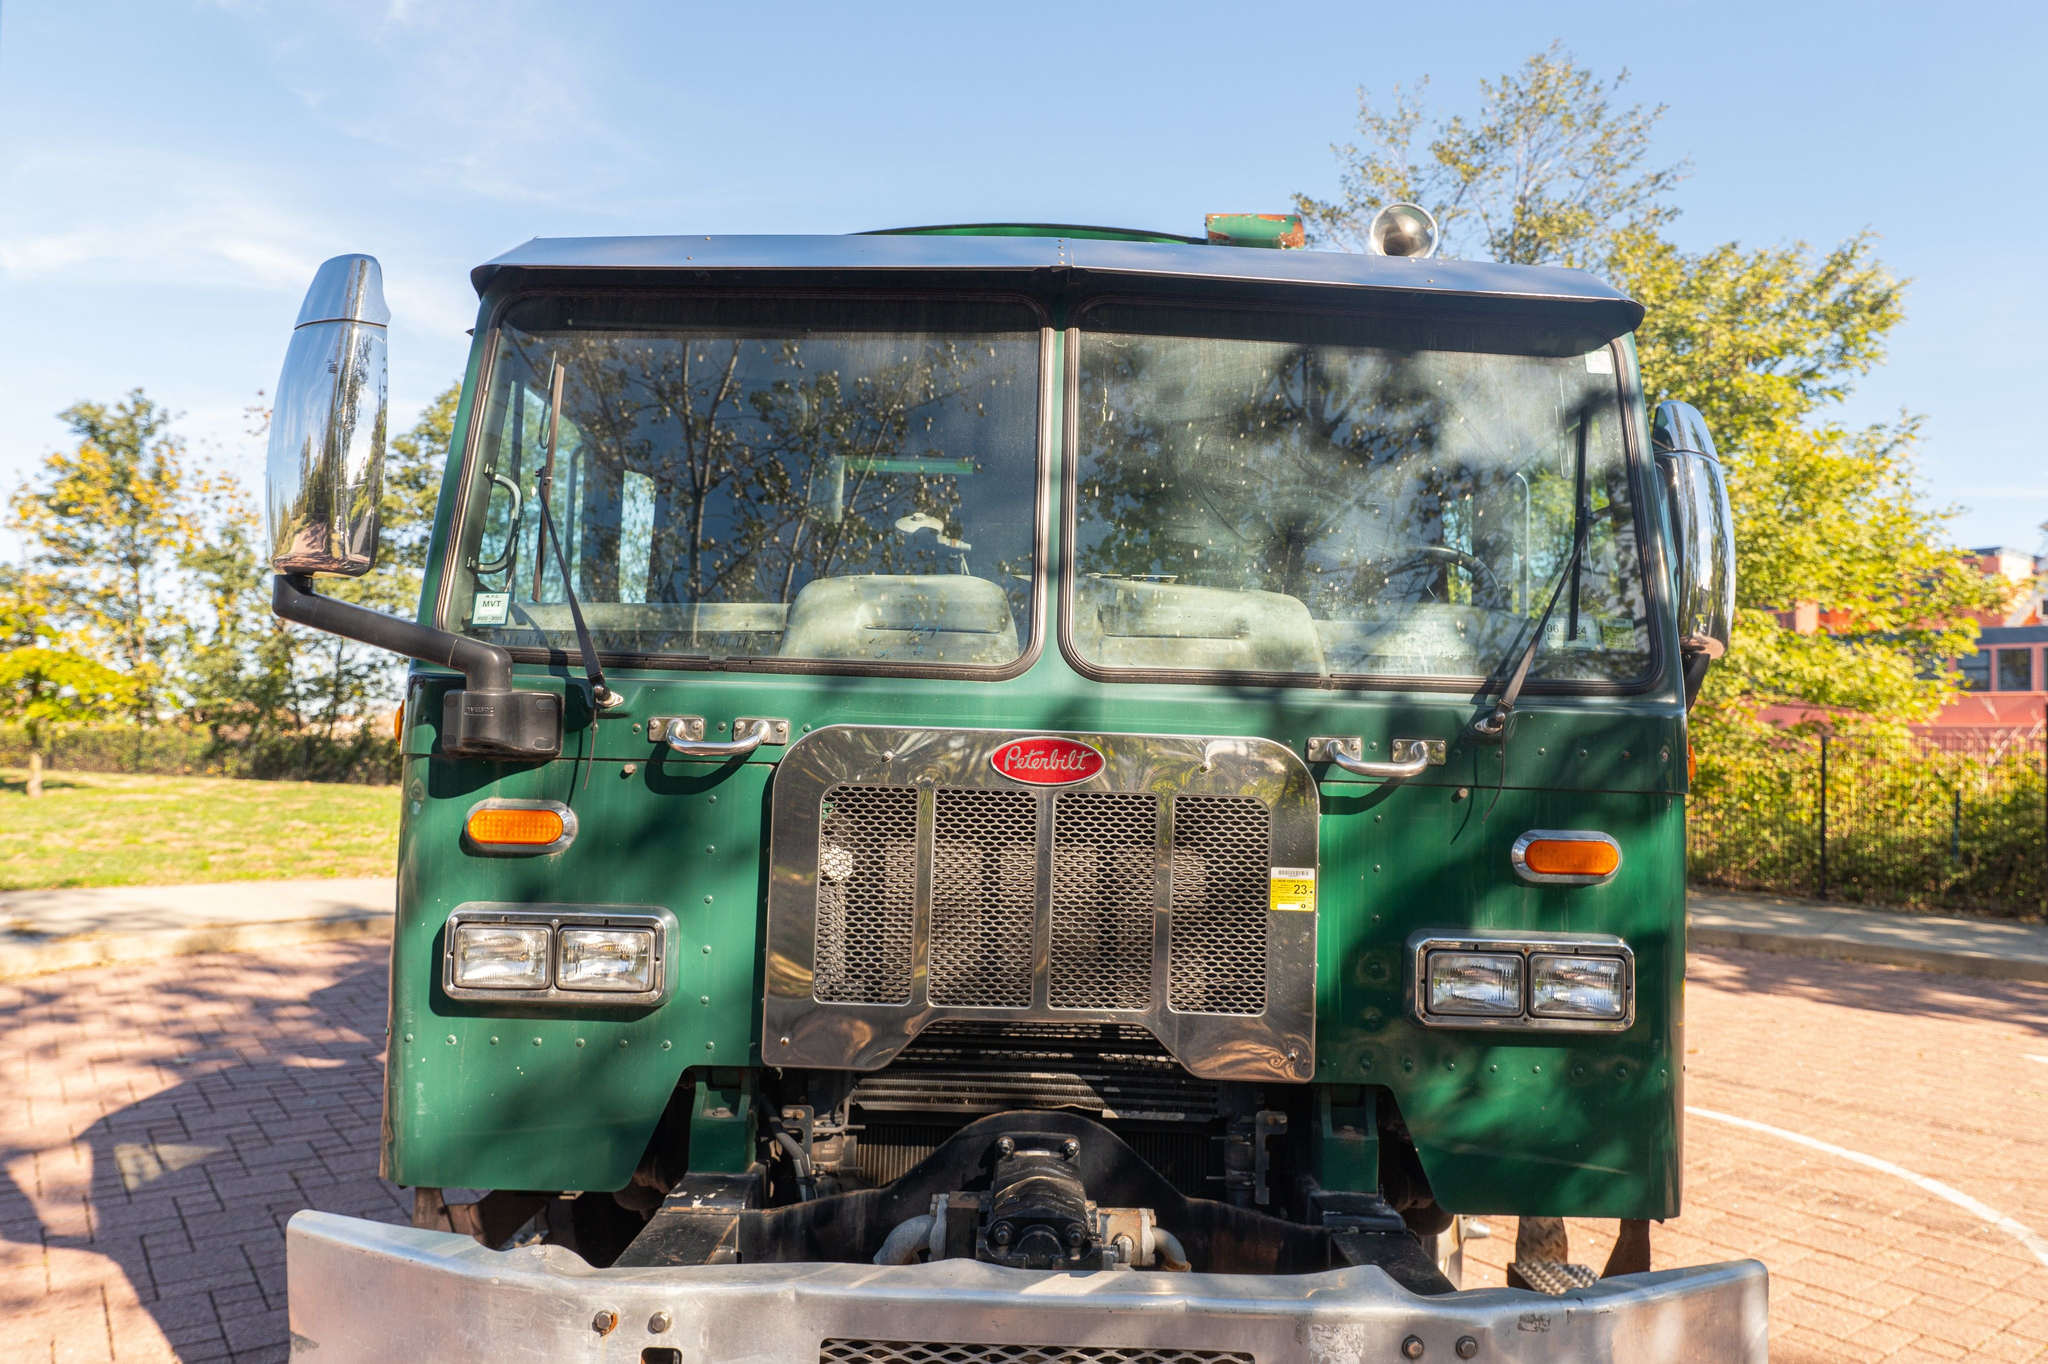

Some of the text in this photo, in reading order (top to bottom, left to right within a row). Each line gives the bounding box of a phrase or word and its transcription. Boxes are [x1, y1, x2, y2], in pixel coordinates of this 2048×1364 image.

[482, 600, 502, 608] MVT
[1546, 623, 1560, 634] 06
[1003, 745, 1095, 771] Peterbilt
[1293, 884, 1308, 895] 23
